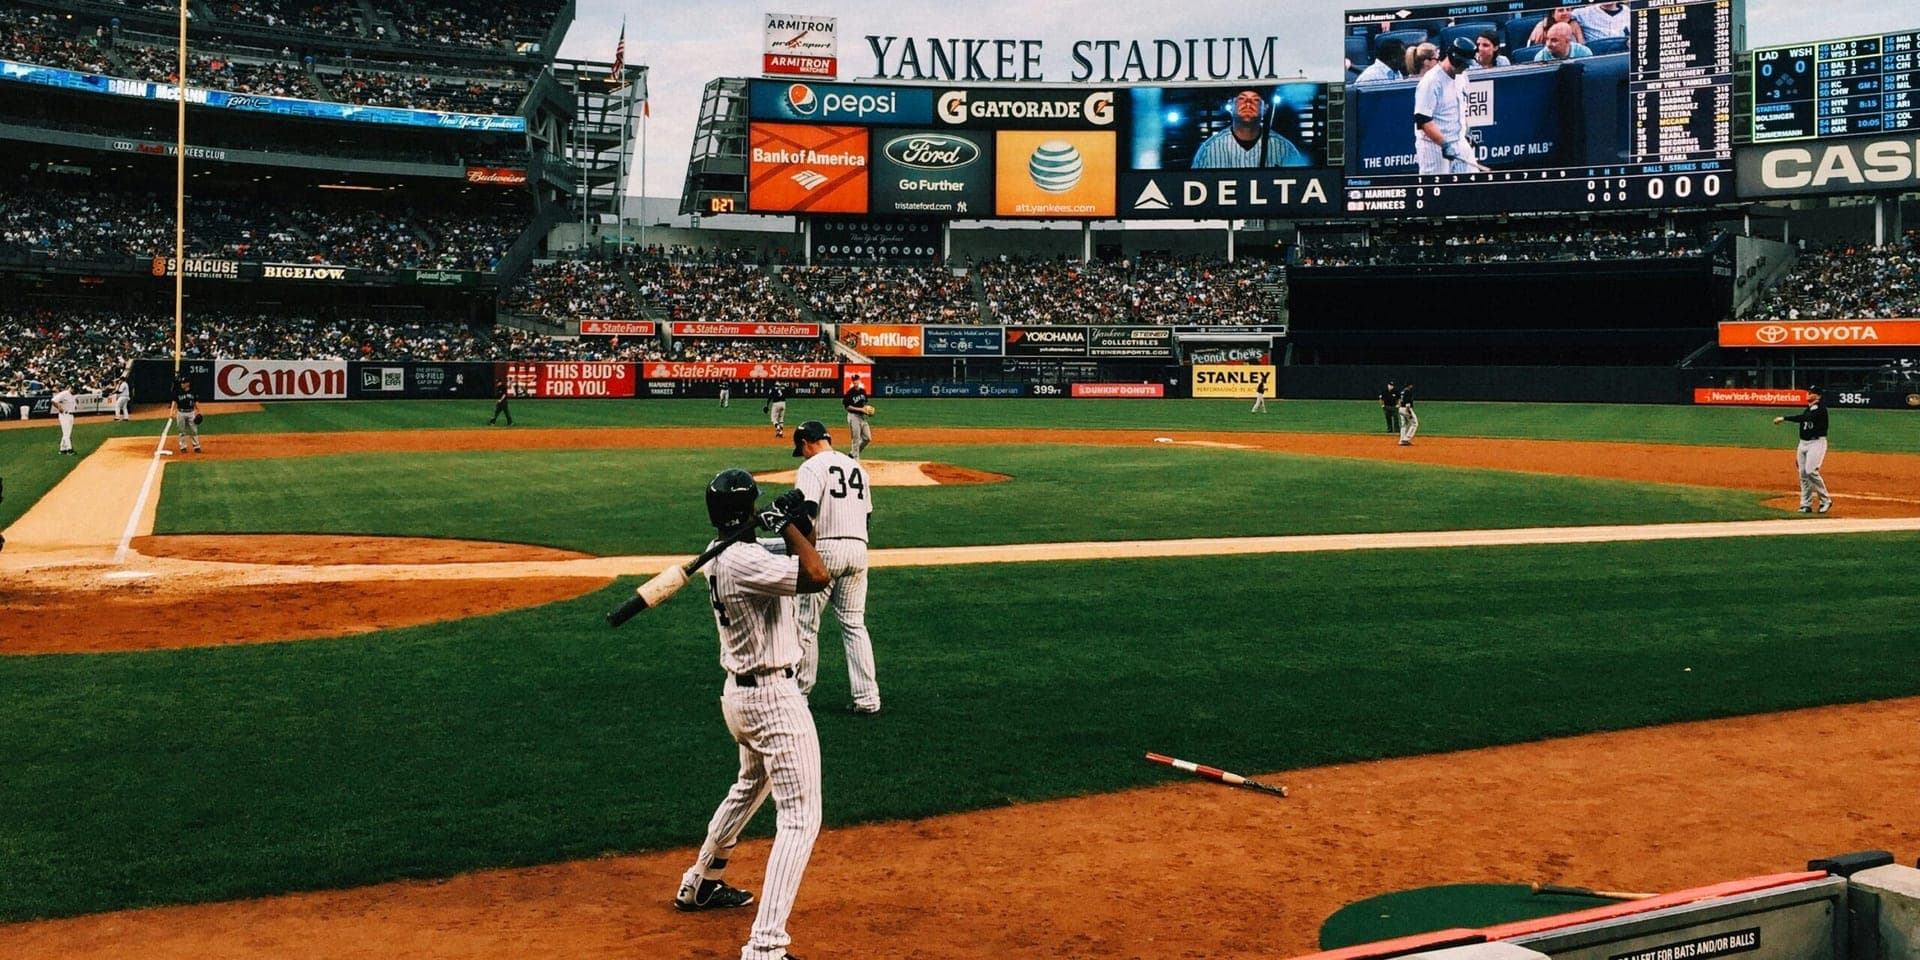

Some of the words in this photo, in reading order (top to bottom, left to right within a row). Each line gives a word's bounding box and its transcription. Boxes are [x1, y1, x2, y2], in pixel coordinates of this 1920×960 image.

[768, 19, 834, 32] ARMITRON
[1659, 28, 1678, 36] CRUZ
[1659, 41, 1690, 50] JACKSON
[1897, 35, 1911, 43] MIA
[864, 35, 1043, 81] YANKEE
[1071, 36, 1278, 82] STADIUM
[1659, 48, 1686, 56] ACKLEY
[1759, 52, 1778, 60] LAD
[1790, 48, 1812, 58] WSH
[771, 57, 830, 68] ARMITRON
[1762, 64, 1772, 76] 0
[1795, 60, 1806, 72] 0
[109, 79, 147, 97] BRIAN
[1659, 90, 1694, 98] ELLSBURY
[823, 92, 896, 118] pepsi
[971, 101, 1081, 118] GATORADE
[1756, 112, 1794, 122] BOLSINGER
[168, 146, 204, 158] YAKEES
[205, 150, 225, 159] CLUB
[753, 148, 789, 163] Bank
[791, 150, 806, 164] of
[807, 150, 865, 166] America
[902, 138, 960, 164] Ford
[1491, 146, 1510, 158] CAP
[1513, 145, 1525, 155] OF
[1364, 157, 1381, 168] THE
[1385, 155, 1418, 167] OFFICIA
[1659, 154, 1688, 162] TANAKA
[1643, 165, 1662, 173] BALLS
[1669, 163, 1696, 172] STRIKES
[1702, 162, 1720, 170] OUTS
[467, 170, 526, 183] Budweiser
[899, 179, 918, 191] Go
[919, 179, 964, 191] Further
[1648, 178, 1664, 199] 0
[1675, 176, 1692, 197] 0
[1704, 174, 1720, 196] 0
[1183, 178, 1328, 206] DELTA
[1365, 189, 1406, 198] MARINERS
[1417, 188, 1424, 196] 0
[895, 201, 952, 211] tristateford.com
[1015, 204, 1096, 215] att.yankees.com
[1365, 202, 1406, 210] YANKEES
[1417, 201, 1424, 209] 0
[167, 258, 239, 273] SRACUSE
[1024, 332, 1085, 342] YOKOHAMA
[1792, 326, 1878, 341] TOYOTA
[860, 332, 920, 349] DraftKings
[1191, 350, 1226, 364] Peanut
[1229, 348, 1262, 360] Chews
[545, 364, 578, 379] THIS
[582, 364, 625, 379] BUD'S
[1197, 372, 1270, 384] STANLEY
[217, 363, 345, 396] Canon
[545, 380, 573, 396] FOR
[577, 381, 610, 396] YOU.
[1120, 386, 1156, 394] DONUTS
[828, 465, 865, 500] 34
[1657, 949, 1672, 960] FOR
[1674, 944, 1696, 960] BATS
[1697, 938, 1729, 954] AND/OR
[1730, 933, 1755, 948] BALLS
